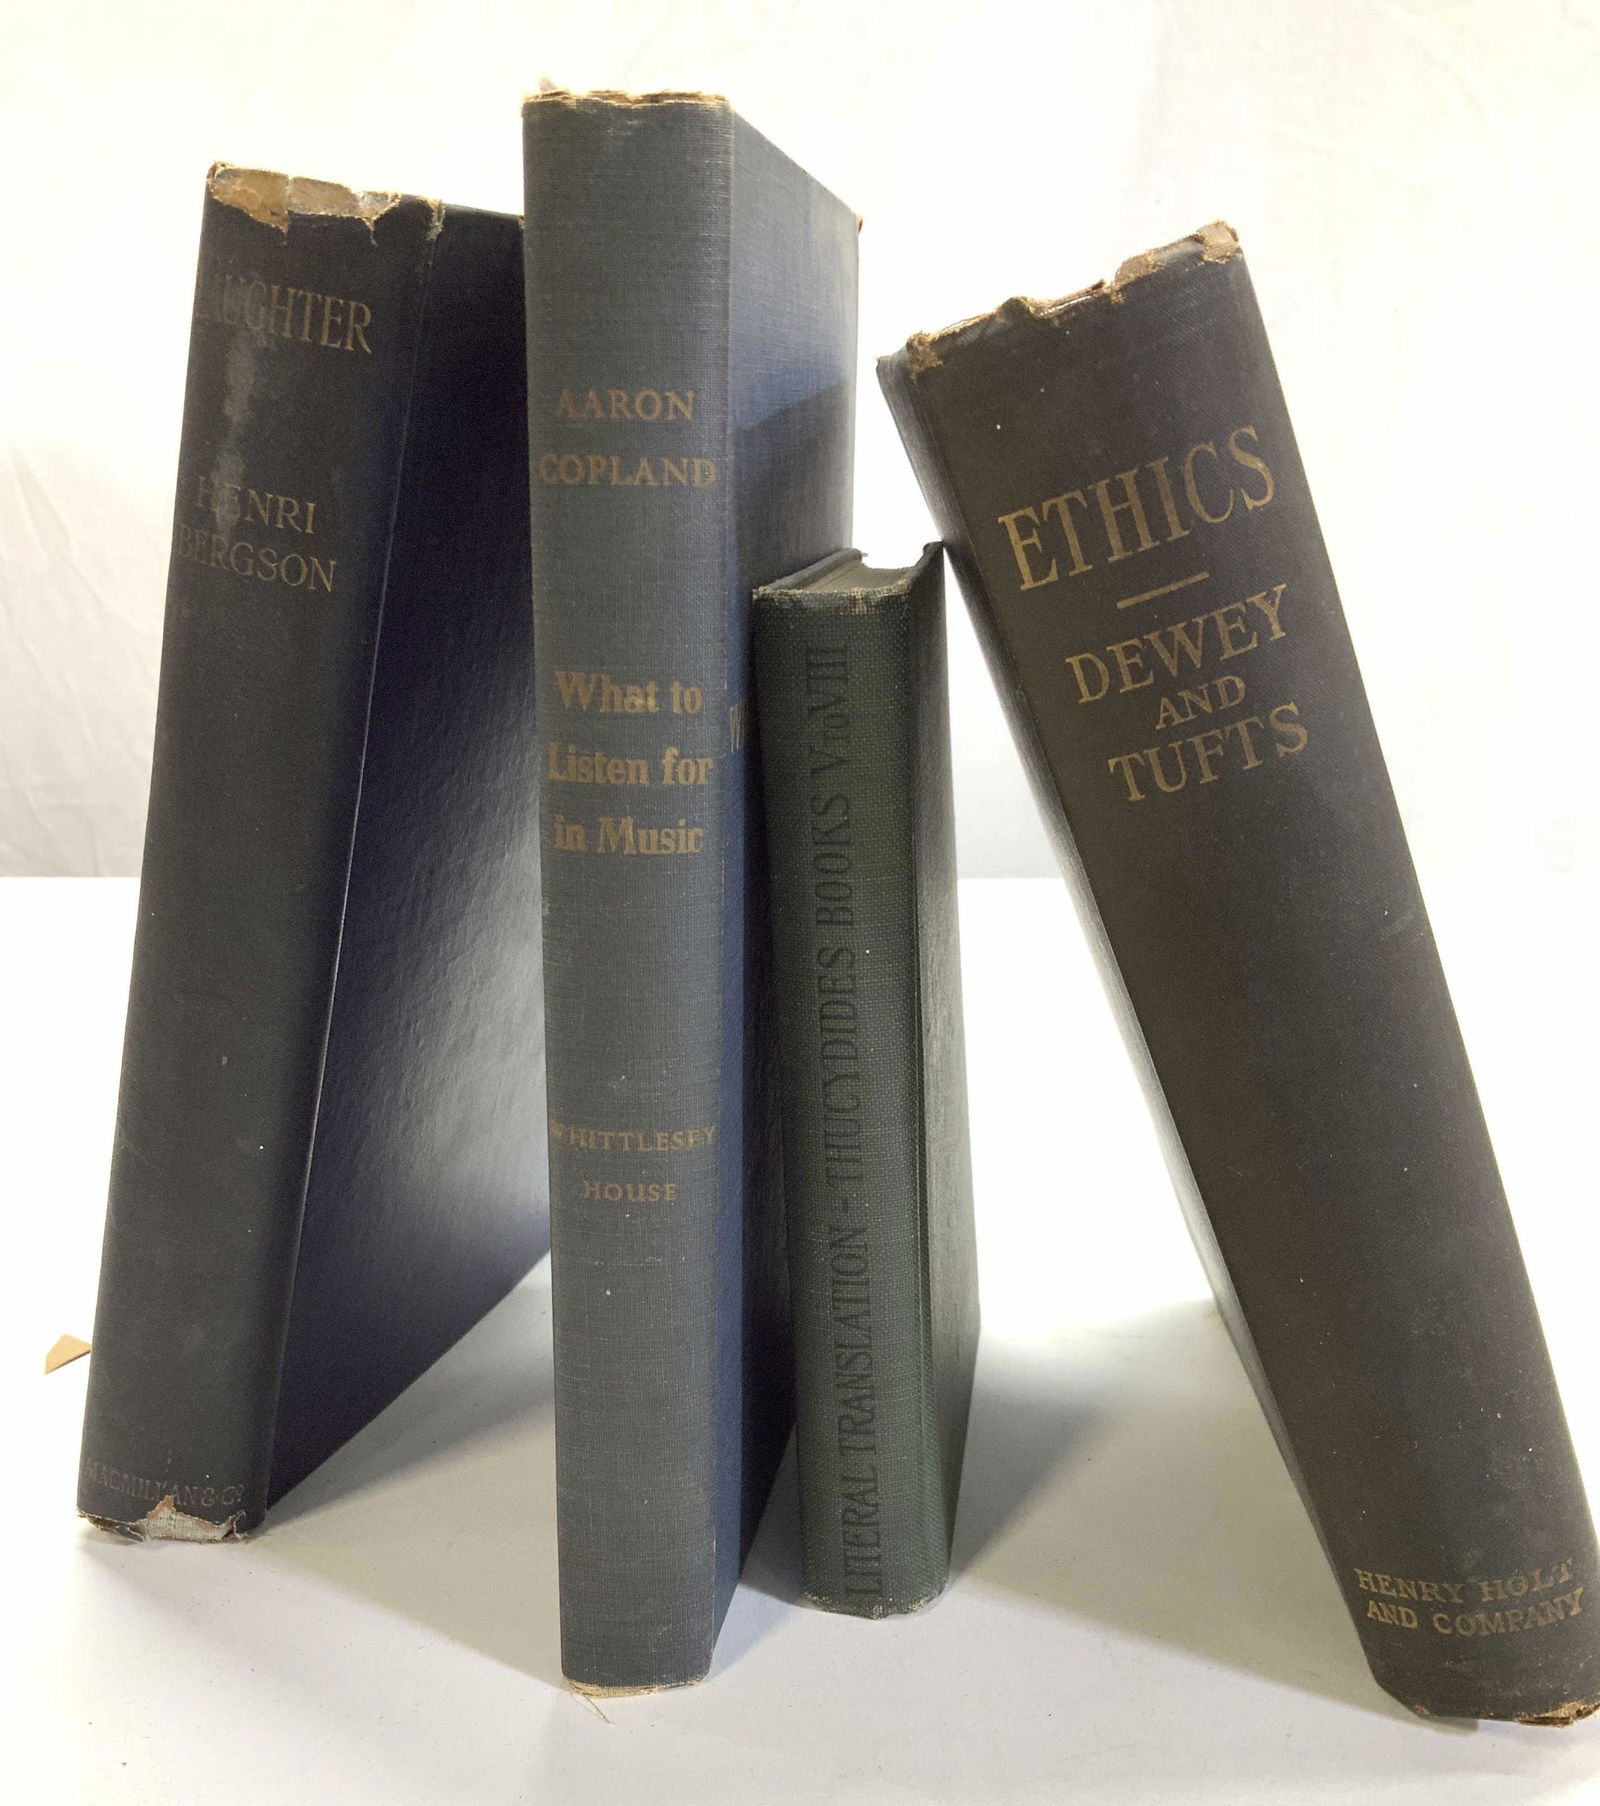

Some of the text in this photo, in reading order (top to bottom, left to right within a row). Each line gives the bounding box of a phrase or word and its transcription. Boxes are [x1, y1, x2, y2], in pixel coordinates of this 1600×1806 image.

[555, 387, 697, 422] AARON
[537, 453, 718, 487] COPLAND
[997, 424, 1276, 592] ETHICS
[177, 522, 339, 594] BERGSON
[1065, 582, 1289, 705] DEWEY
[554, 670, 704, 714] What to
[1155, 675, 1247, 730] AND
[546, 741, 714, 785] Listen for
[1107, 701, 1310, 802] TUFTS
[553, 814, 704, 856] in Music
[811, 792, 853, 927] BOOKS
[818, 945, 863, 1189] THUCYDIDES
[583, 1180, 678, 1203] HOUSE
[829, 1224, 878, 1458] TRANSLATION
[839, 1464, 883, 1599] LITERAL
[1354, 1557, 1575, 1604] HENRY HOLT
[1366, 1586, 1585, 1637] AND COMPANY
